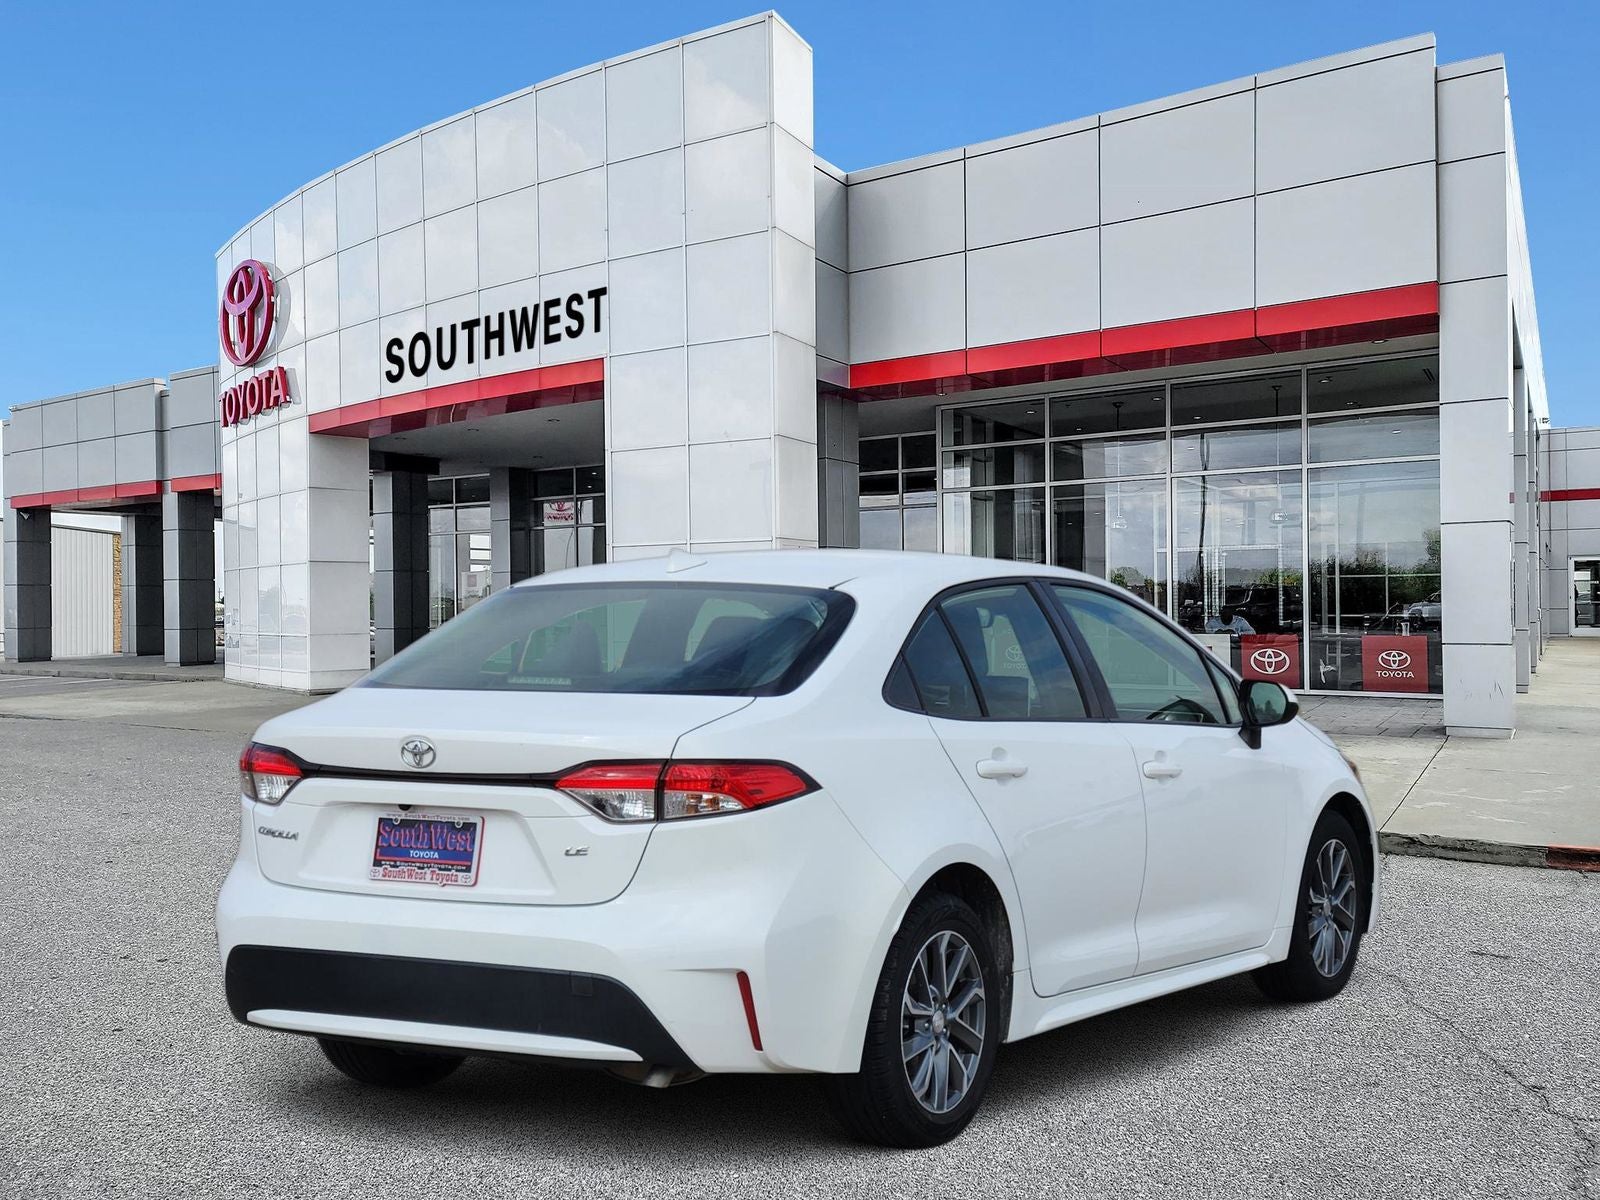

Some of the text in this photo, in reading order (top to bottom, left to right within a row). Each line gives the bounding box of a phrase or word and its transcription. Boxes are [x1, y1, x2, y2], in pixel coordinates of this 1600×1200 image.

[384, 286, 608, 384] SOUTHWEST
[219, 366, 290, 428] TOYOTA
[1375, 669, 1415, 679] TOYOTA
[409, 850, 439, 859] TOYOTA
[564, 846, 590, 857] LE
[430, 870, 459, 883] Toyota
